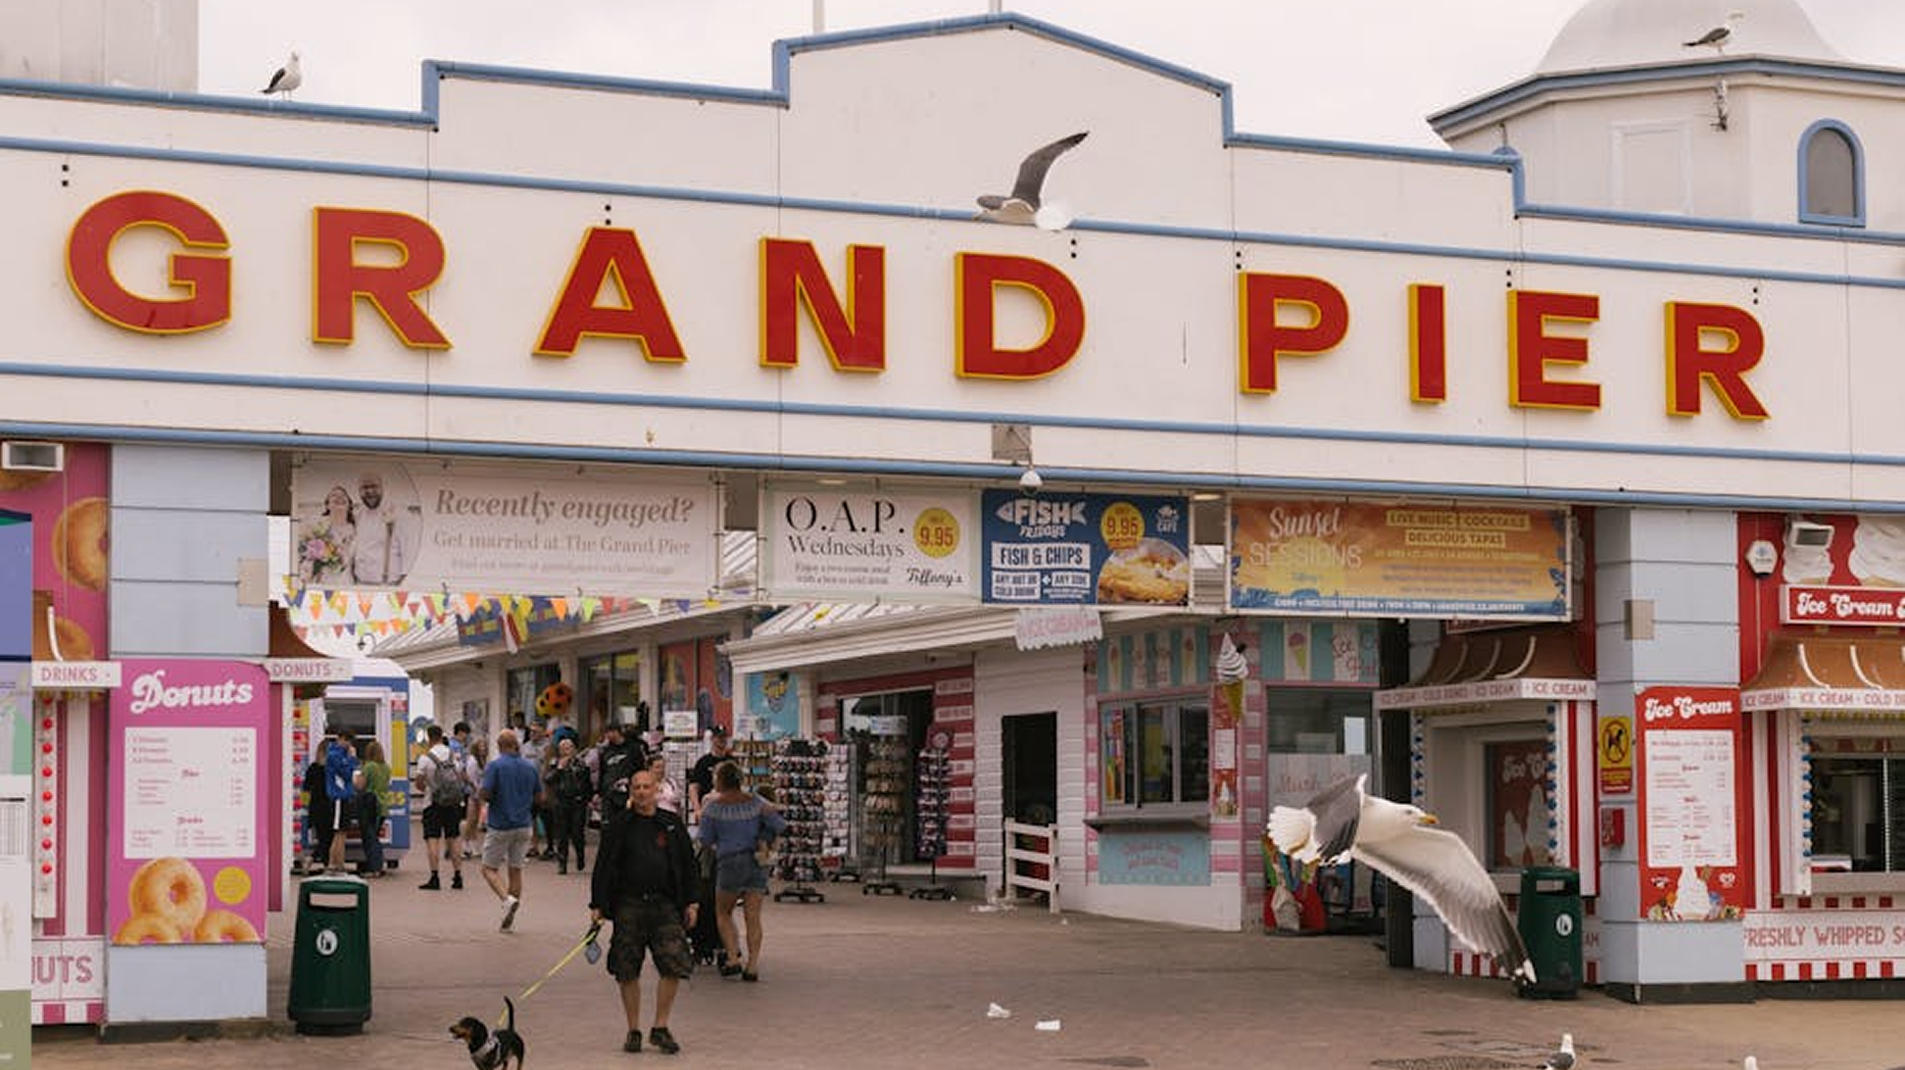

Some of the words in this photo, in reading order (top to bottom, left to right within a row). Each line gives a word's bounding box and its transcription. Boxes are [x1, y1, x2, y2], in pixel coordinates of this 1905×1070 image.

[65, 189, 1085, 382] GRAND
[1239, 271, 1772, 422] PIER
[436, 488, 555, 523] Recently
[560, 497, 694, 528] engaged?
[785, 496, 906, 534] O.A.P.
[1014, 498, 1072, 526] FISH
[1269, 507, 1342, 539] Sunset
[433, 530, 464, 550] Get
[468, 532, 539, 551] married
[542, 535, 560, 551] at
[563, 535, 597, 552] The
[599, 536, 655, 555] Grand
[658, 539, 692, 556] Pier
[787, 535, 906, 562] Wednesdays
[919, 526, 955, 548] 9.95
[1407, 531, 1468, 545] DELICIOUS
[1000, 547, 1028, 565] FISH
[1032, 548, 1042, 565] &
[1045, 547, 1083, 565] CHIPS
[1249, 541, 1363, 569] SESSIONS
[1796, 592, 1828, 617] Ice
[1829, 592, 1894, 618] Cream
[41, 666, 98, 683] DRINKS
[270, 661, 331, 678] DONUTS
[129, 669, 253, 715] Donuts
[1532, 682, 1549, 694] ICE
[1552, 682, 1588, 695] CREAM
[1800, 691, 1816, 703] ICE
[1818, 691, 1853, 704] CREAM
[1864, 692, 1893, 706] COLD
[1645, 697, 1674, 722] Ice
[1673, 696, 1734, 720] Cream
[1813, 925, 1887, 946] WHIPPED
[31, 955, 94, 985] UTS
